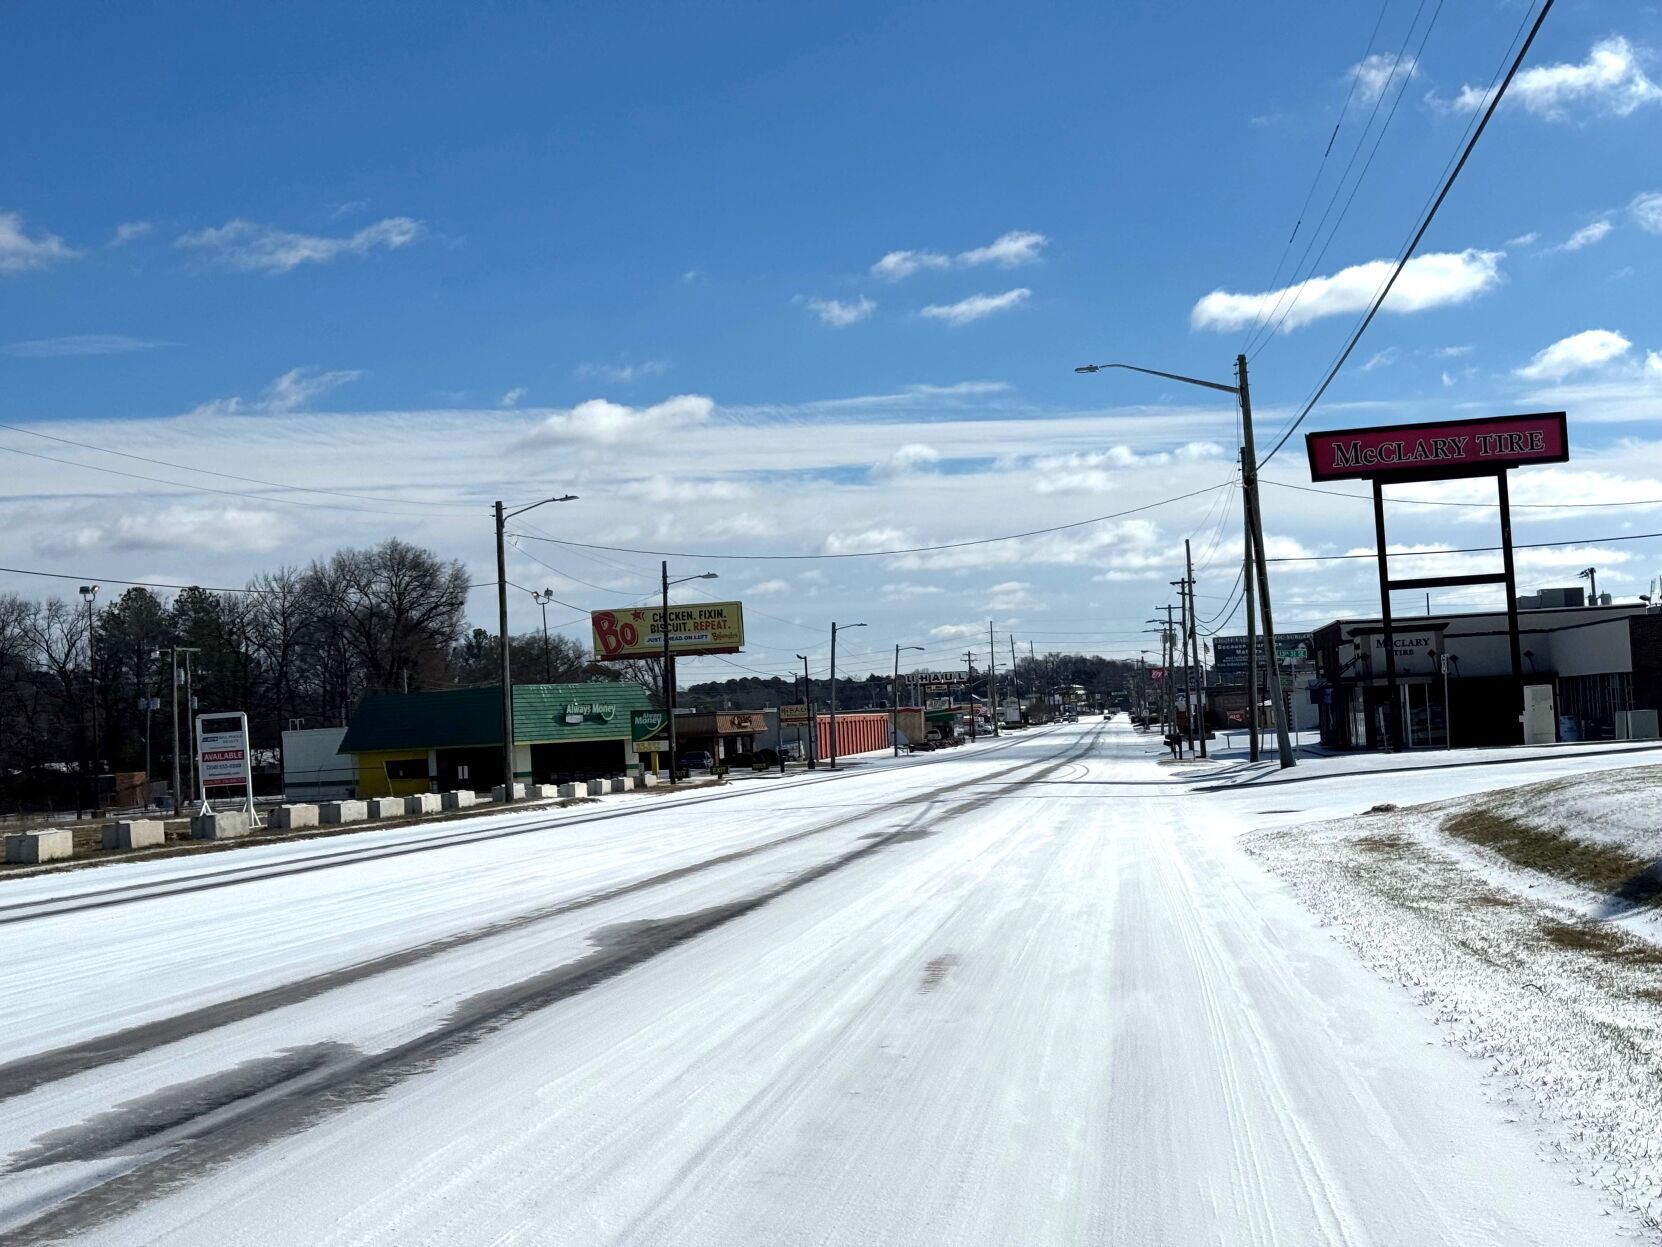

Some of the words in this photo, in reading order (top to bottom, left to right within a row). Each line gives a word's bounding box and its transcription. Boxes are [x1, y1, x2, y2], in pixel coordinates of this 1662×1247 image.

[1332, 436, 1469, 468] McCLARY
[1475, 430, 1545, 456] TIRE
[652, 610, 696, 622] CHCKEN.
[699, 608, 727, 620] FIXIN.
[693, 619, 731, 632] REPEAT.
[592, 611, 639, 656] Bo
[1376, 637, 1430, 649] MCLARY
[566, 703, 591, 715] Always
[592, 703, 616, 717] Money
[635, 716, 662, 727] Money
[204, 752, 243, 761] AVAILABLE
